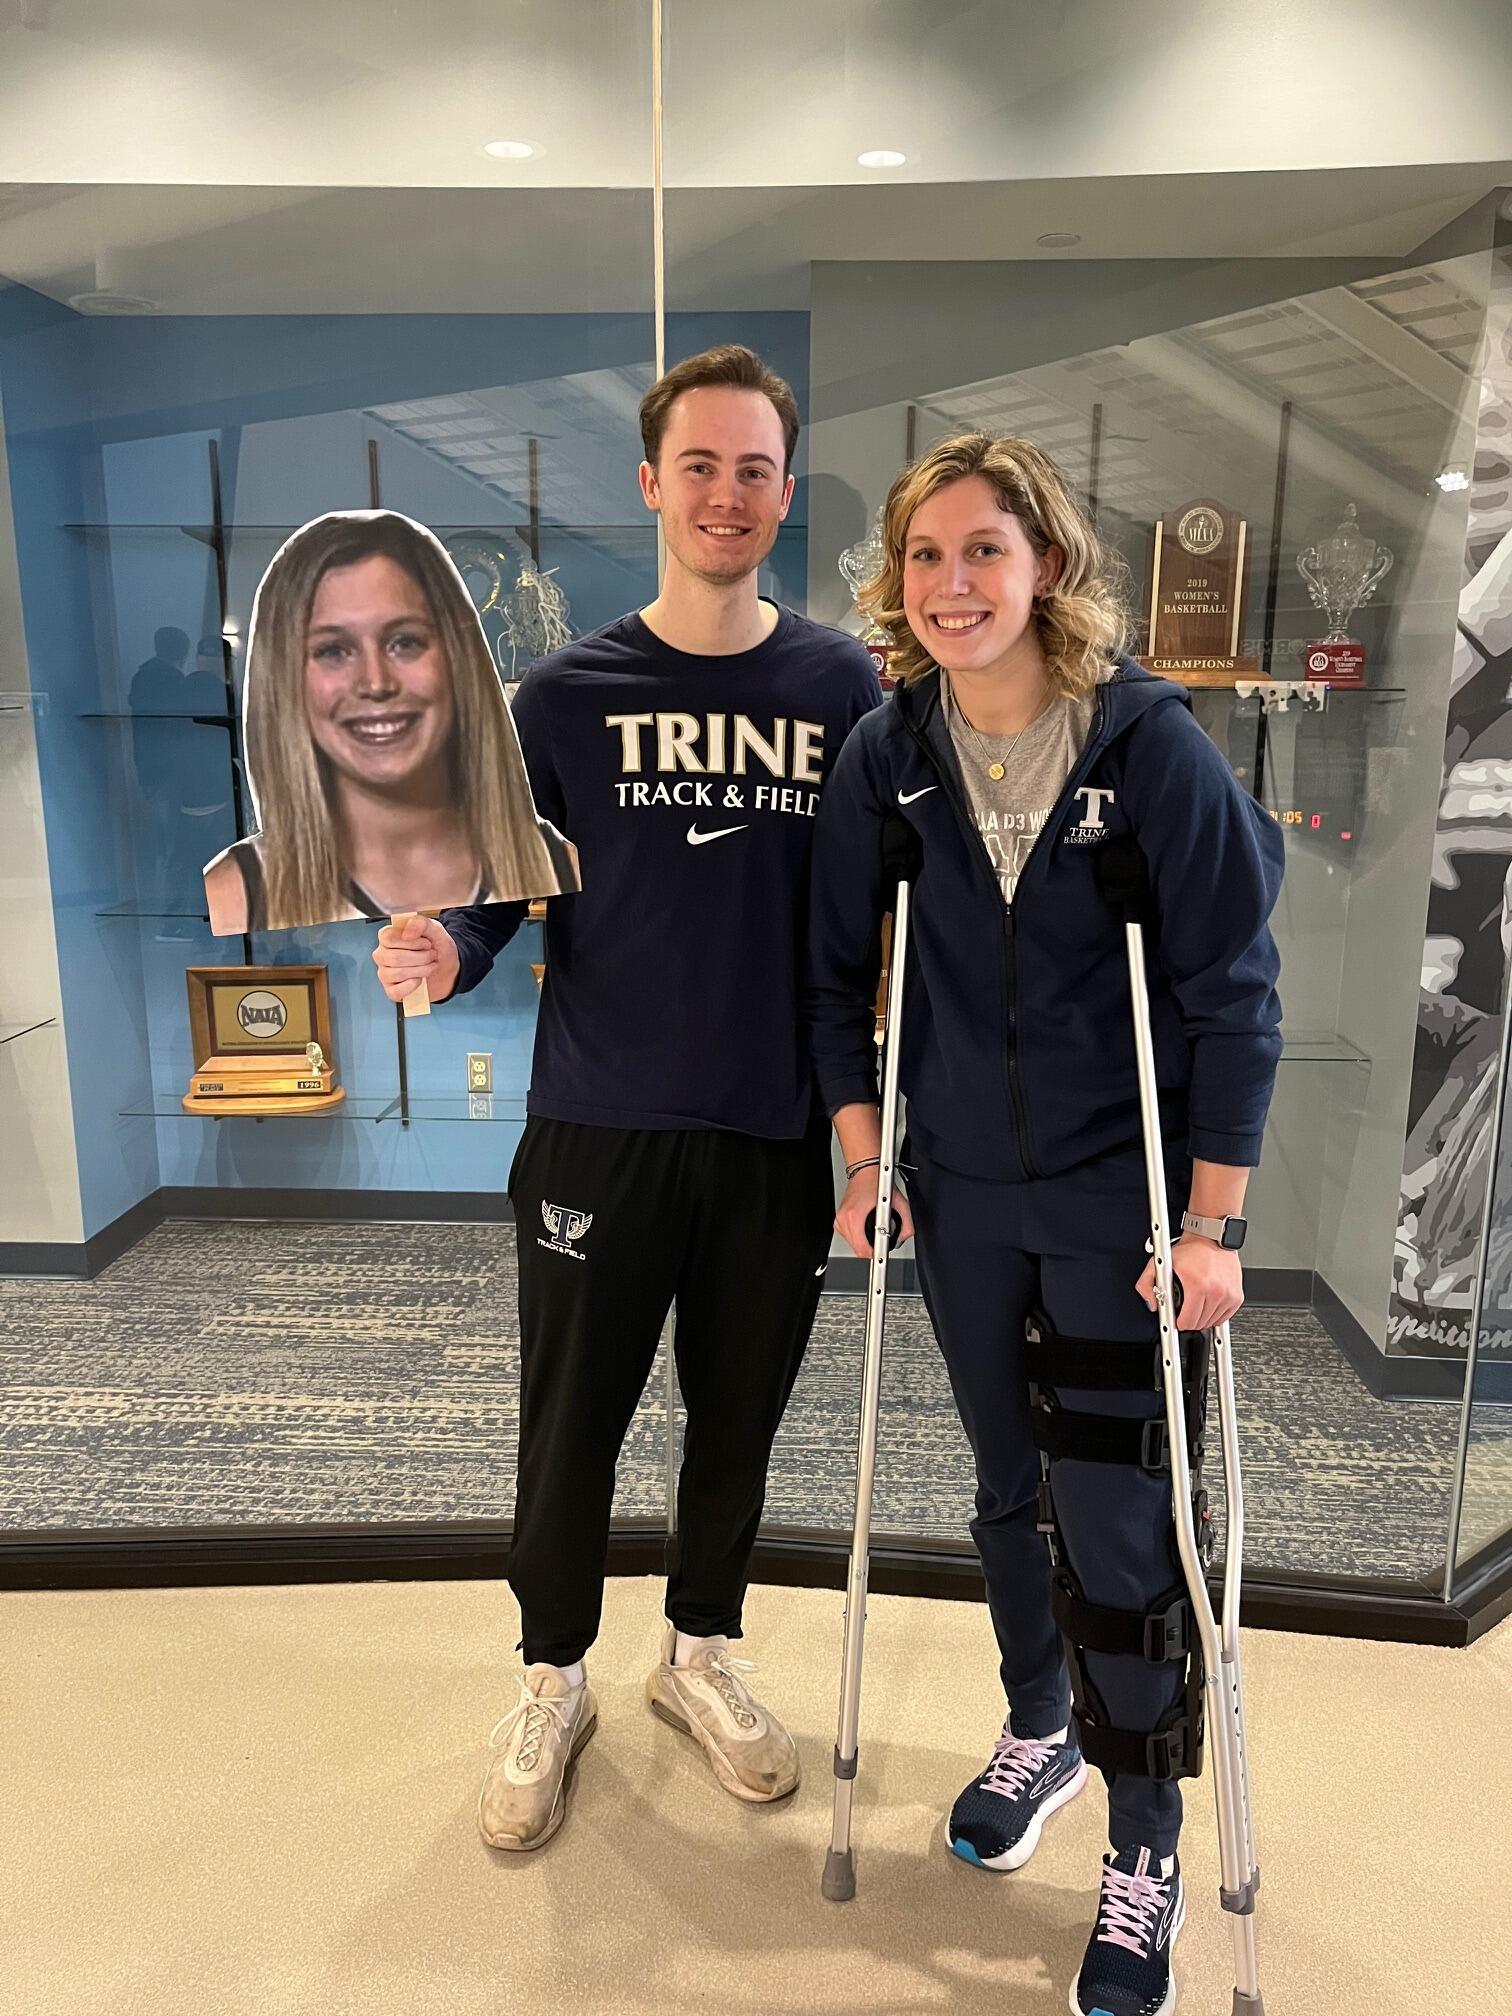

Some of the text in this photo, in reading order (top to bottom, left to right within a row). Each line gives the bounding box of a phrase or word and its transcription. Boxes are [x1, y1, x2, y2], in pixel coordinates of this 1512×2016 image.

[1187, 579, 1208, 588] 2019
[1174, 591, 1220, 601] WOMEN'S
[1164, 604, 1228, 614] BASKETBALL
[1153, 659, 1234, 669] CHAMPIONS
[605, 713, 825, 784] TRINE
[615, 782, 821, 817] TRACK & FIELD
[1074, 787, 1115, 828] T
[1003, 813, 1026, 831] D3
[1063, 834, 1110, 844] BASKET
[240, 1004, 284, 1027] NAIA
[299, 1081, 320, 1090] 1996
[537, 1237, 559, 1251] TRACK
[564, 1248, 586, 1261] FIELD
